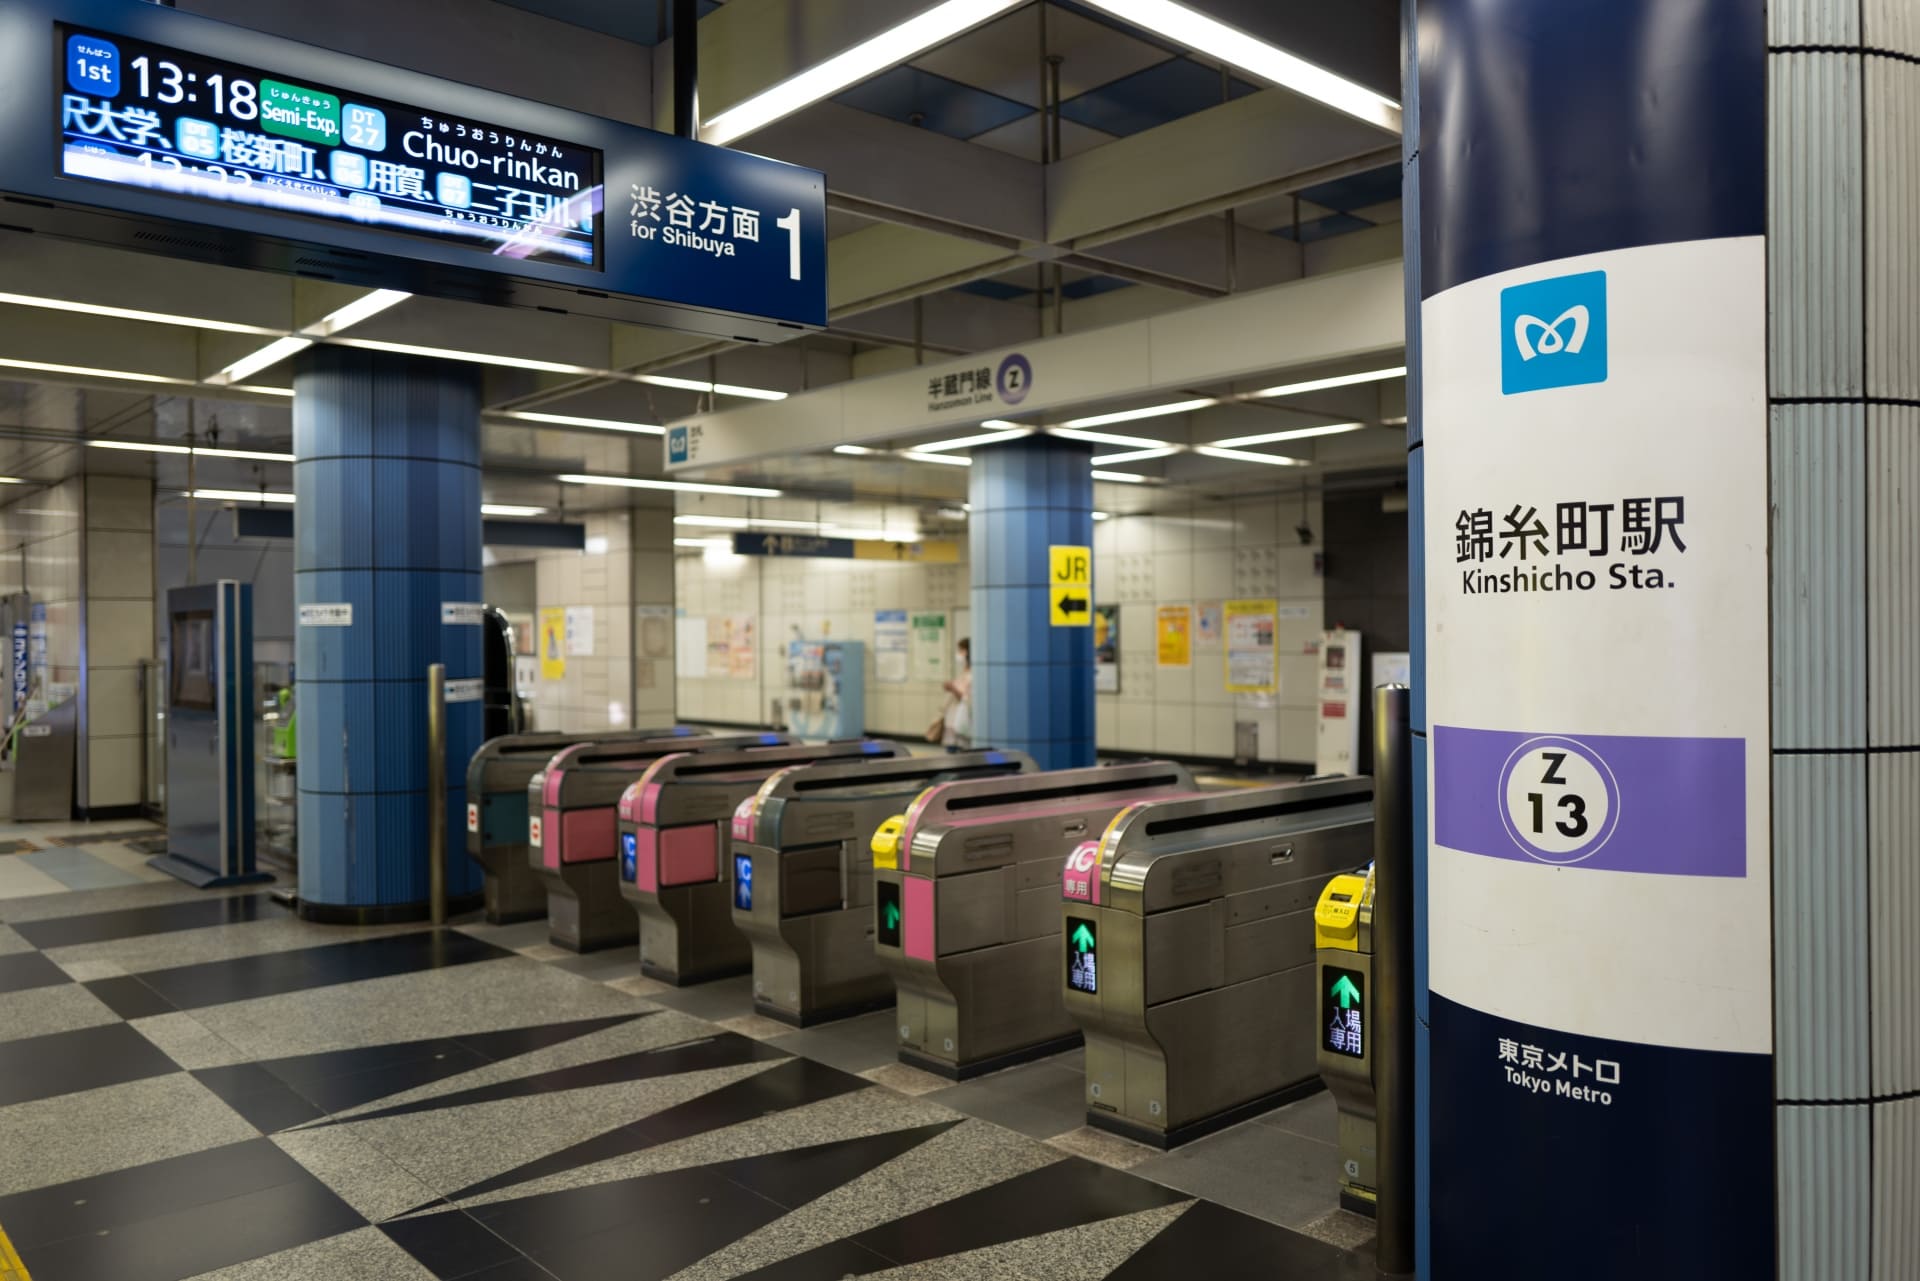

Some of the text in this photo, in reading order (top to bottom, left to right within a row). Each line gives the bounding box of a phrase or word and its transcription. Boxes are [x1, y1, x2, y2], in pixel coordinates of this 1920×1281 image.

[77, 45, 112, 59] せんばつ
[76, 58, 112, 83] 1st
[131, 56, 258, 121] 13:18
[270, 87, 331, 109] じゅんきゅう
[261, 100, 340, 138] Semi-Exp.
[351, 109, 375, 127] DT
[349, 124, 379, 147] 27
[420, 116, 563, 159] ちゅうおうりんかん
[402, 131, 579, 191] Chuo-rinkan
[630, 183, 760, 243] 渋谷方面
[630, 220, 735, 258] for Shibuya
[776, 207, 801, 280] 1
[1008, 370, 1019, 389] Z
[1456, 496, 1687, 563] 錦糸町駅
[1057, 556, 1087, 581] JR
[1463, 562, 1674, 594] Kinshicho Sta.
[1540, 752, 1567, 785] Z
[1527, 792, 1588, 838] 13
[1065, 845, 1098, 873] IC
[1329, 1006, 1362, 1033] 入場
[1329, 1027, 1362, 1055] 専用
[1498, 1037, 1620, 1085] 東京メトロ
[1504, 1065, 1612, 1105] Tokyo Metro
